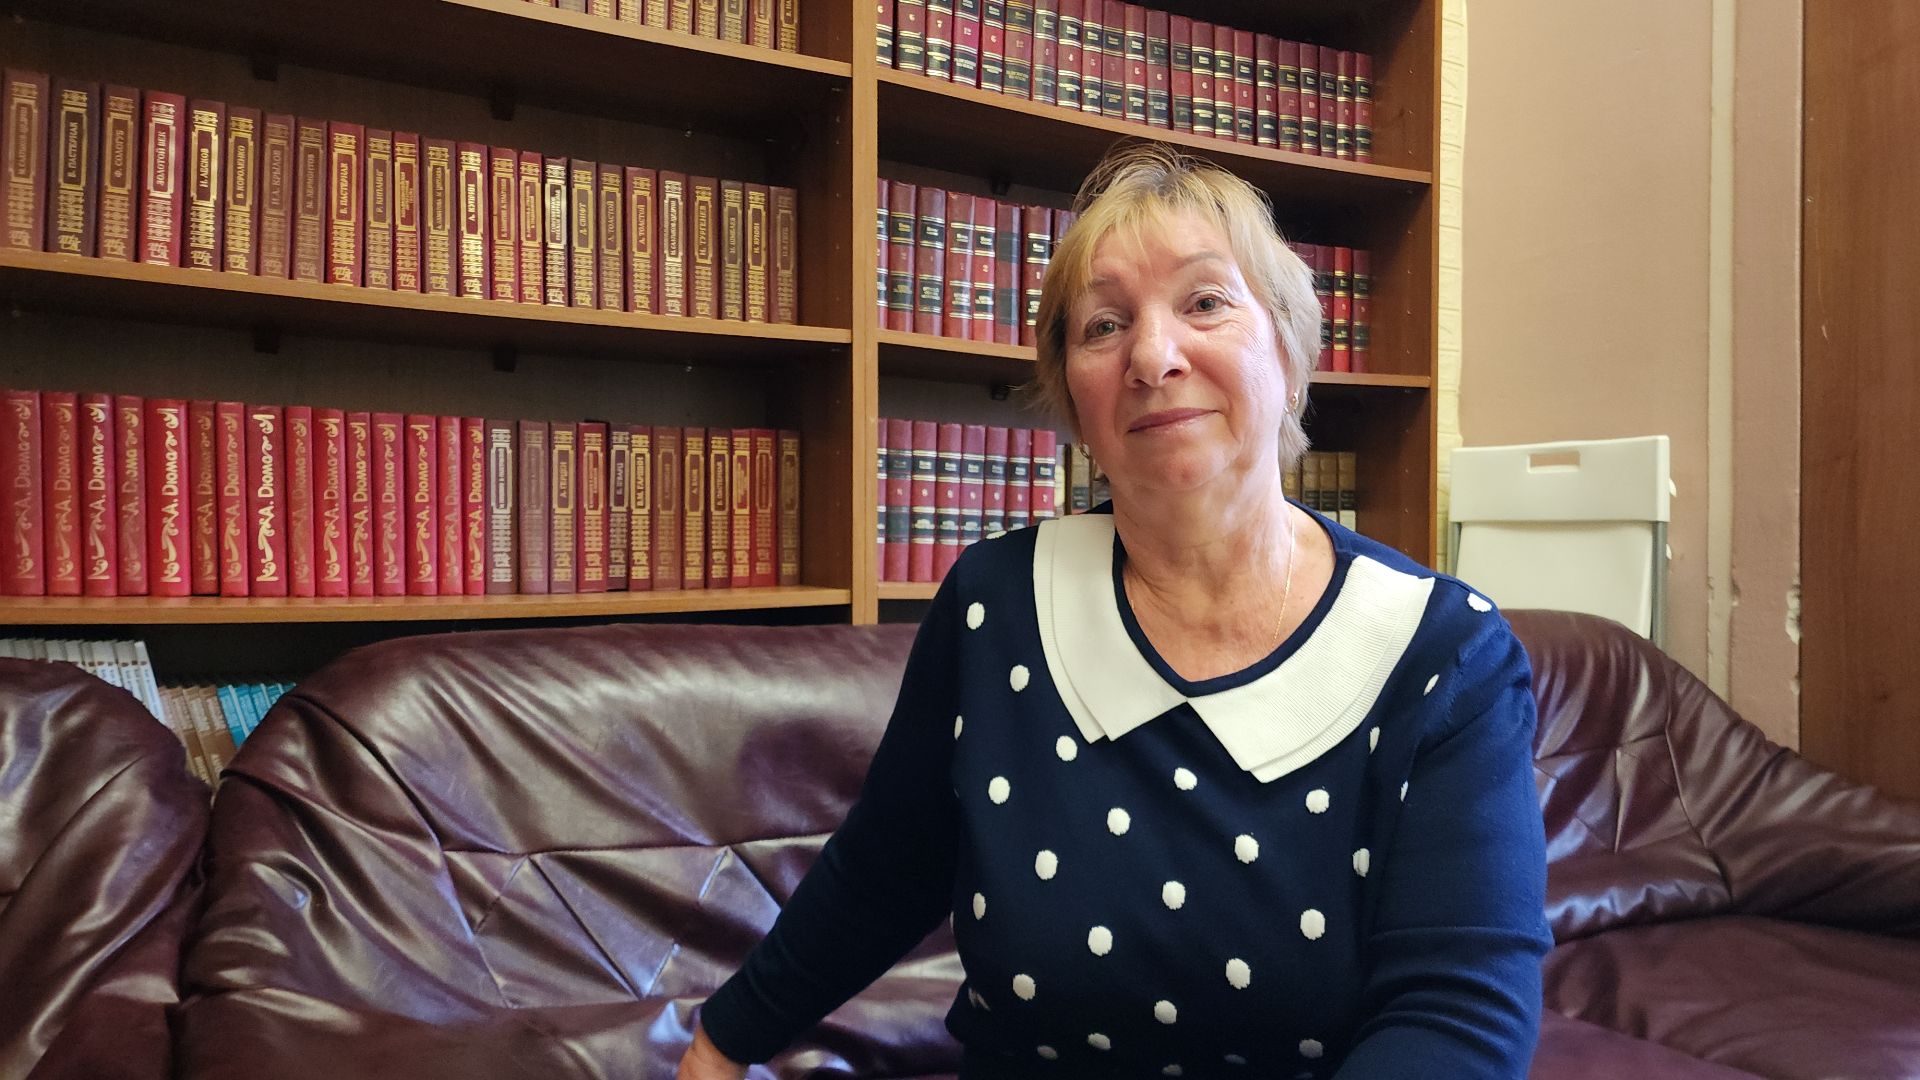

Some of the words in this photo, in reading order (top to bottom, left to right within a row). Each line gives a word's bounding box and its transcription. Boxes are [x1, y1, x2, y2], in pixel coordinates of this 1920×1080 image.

[68, 121, 78, 169] ПАСТЕРНАК
[114, 129, 124, 167] СОЛОГУБ
[157, 130, 166, 147] ВЕК
[114, 168, 123, 178] Ф.
[156, 148, 166, 186] ЗОЛОТОЙ
[200, 147, 209, 179] ЛЕСКОВ
[235, 144, 246, 191] КОРОЛЕНКО
[271, 149, 282, 186] КРЫЛОВ
[306, 153, 315, 198] ЛЕРМОНТОВ
[340, 162, 349, 206] ПАСТЕРНАК
[375, 168, 384, 205] КИПЛИНГ
[376, 206, 384, 214] Р.
[606, 200, 614, 233] ТОЛСТОЙ
[637, 204, 645, 236] ТОЛСТОЙ
[698, 205, 707, 246] ТУРГЕНЕВ
